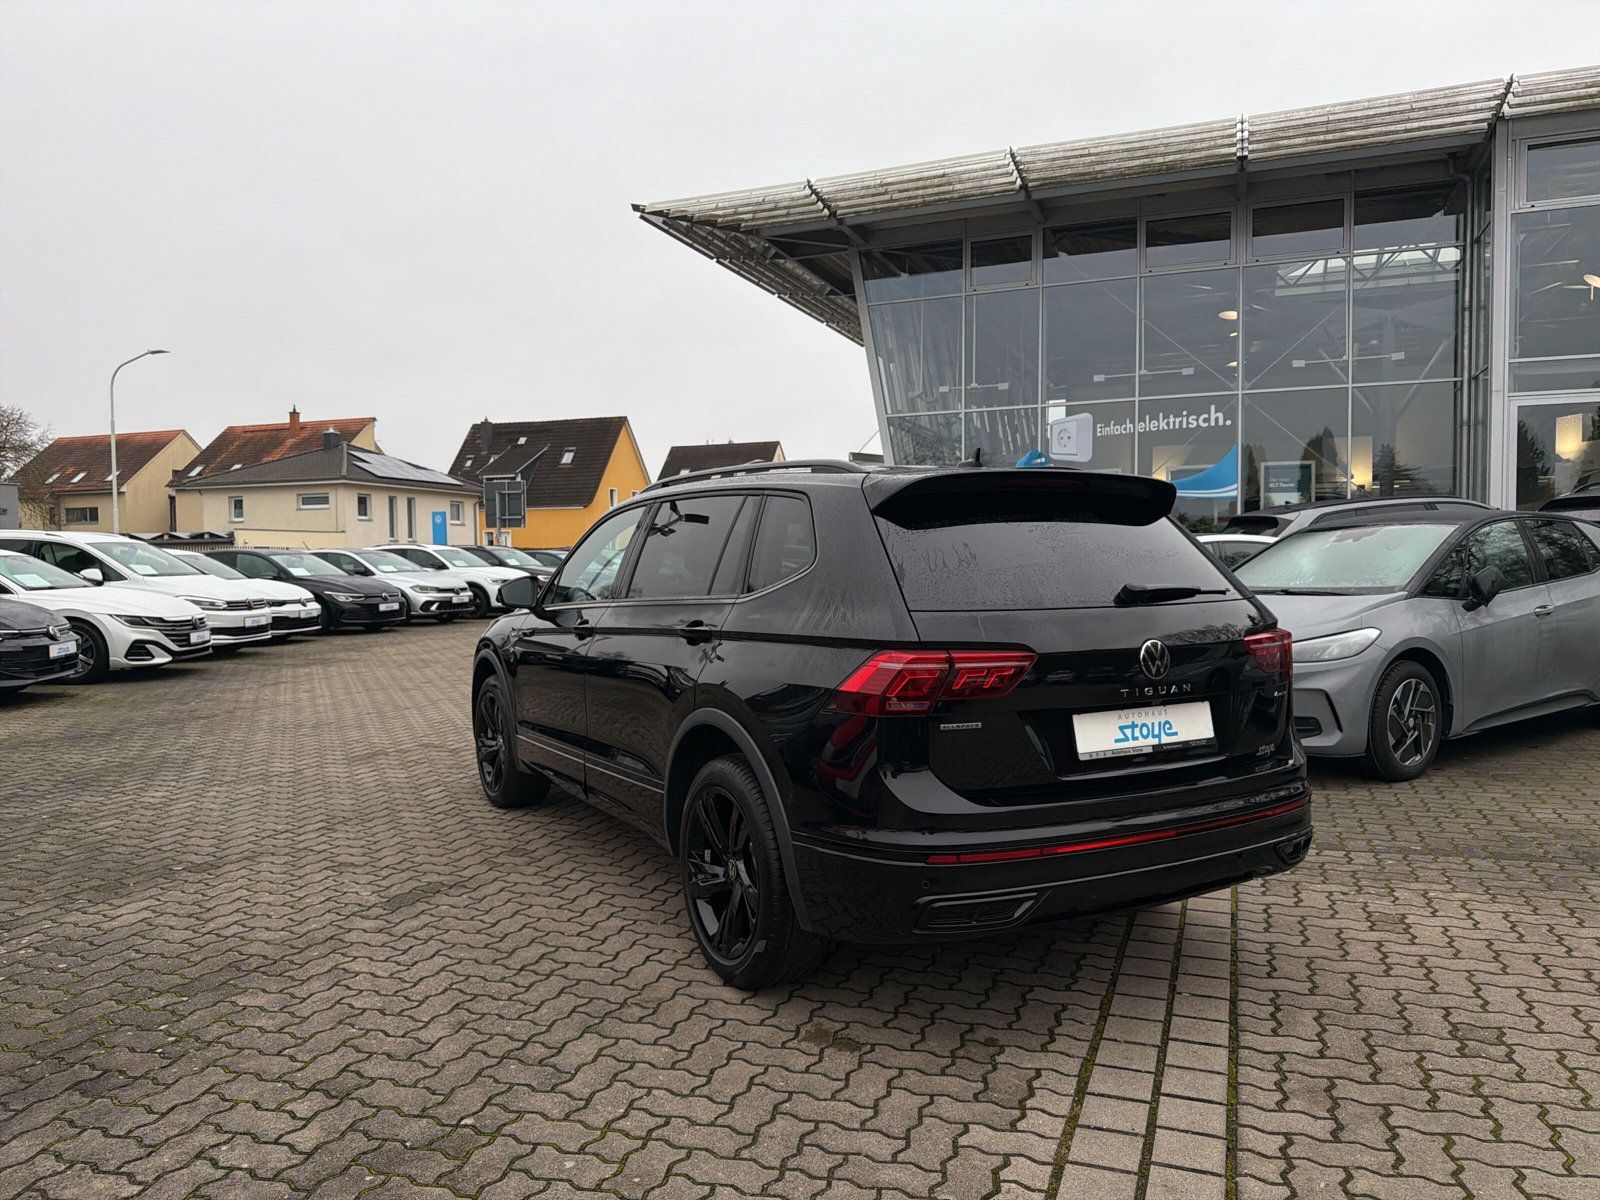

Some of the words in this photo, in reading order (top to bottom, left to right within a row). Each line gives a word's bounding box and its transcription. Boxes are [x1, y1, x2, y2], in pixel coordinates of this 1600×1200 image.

[1096, 418, 1134, 437] Einfach
[1138, 404, 1232, 432] elektrisch.
[1120, 683, 1191, 698] TIGUAN
[1117, 709, 1169, 720] AUTOHAUS
